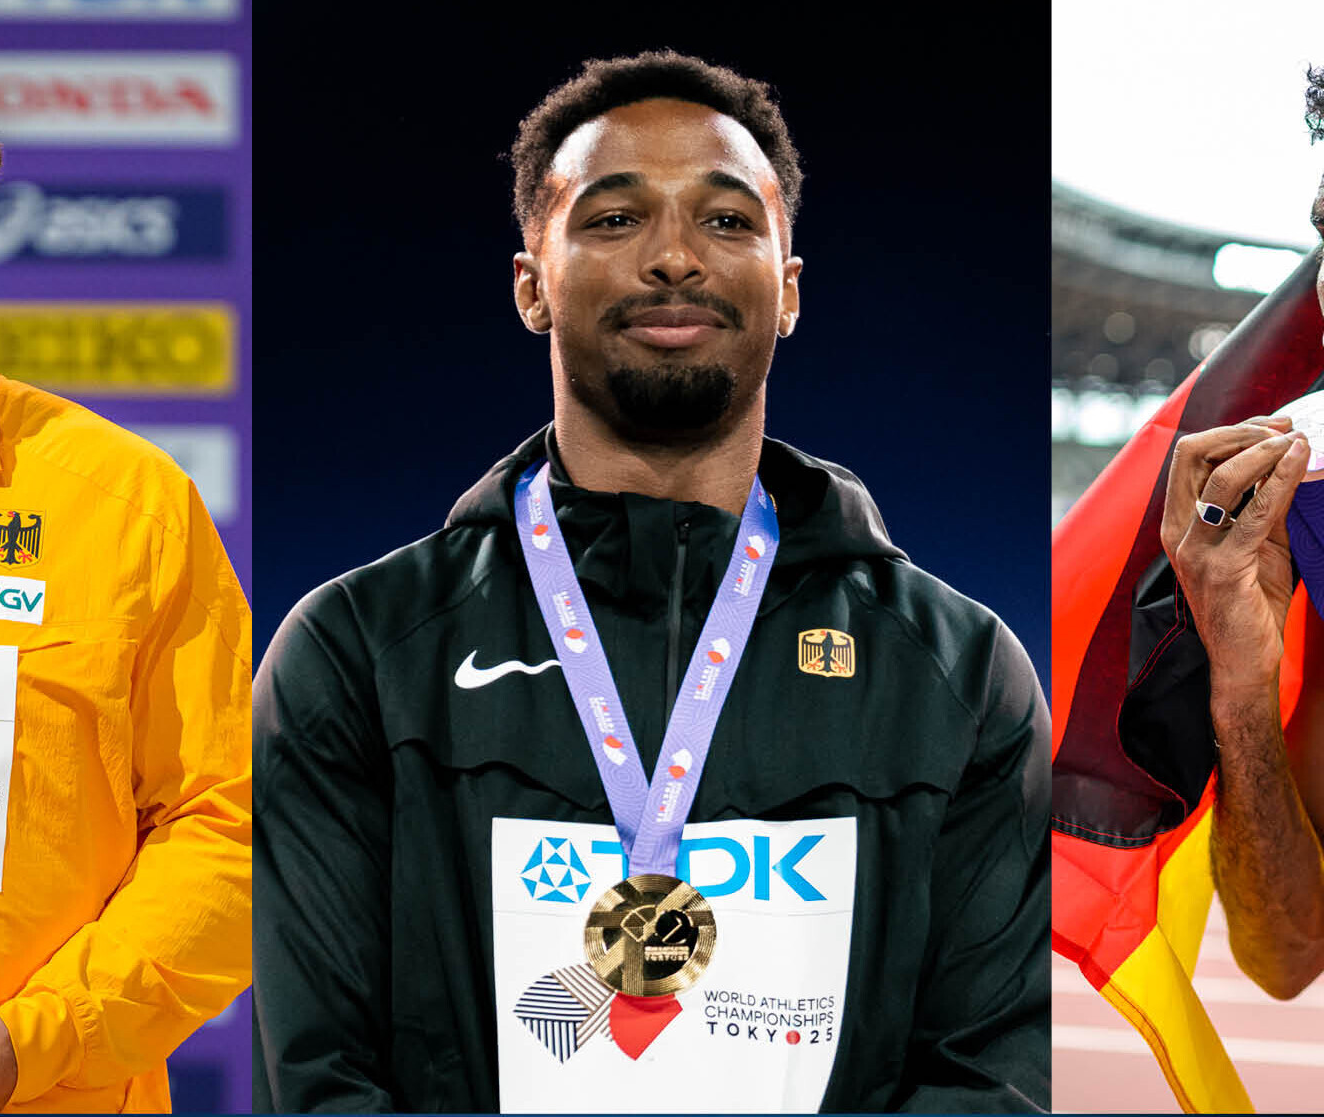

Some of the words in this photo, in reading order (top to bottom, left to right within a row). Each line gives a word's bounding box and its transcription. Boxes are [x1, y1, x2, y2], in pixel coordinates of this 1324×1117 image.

[704, 990, 756, 1007] WORLD
[760, 995, 835, 1011] ATHLETICS
[704, 1005, 834, 1027] CHAMPIONSHIPS
